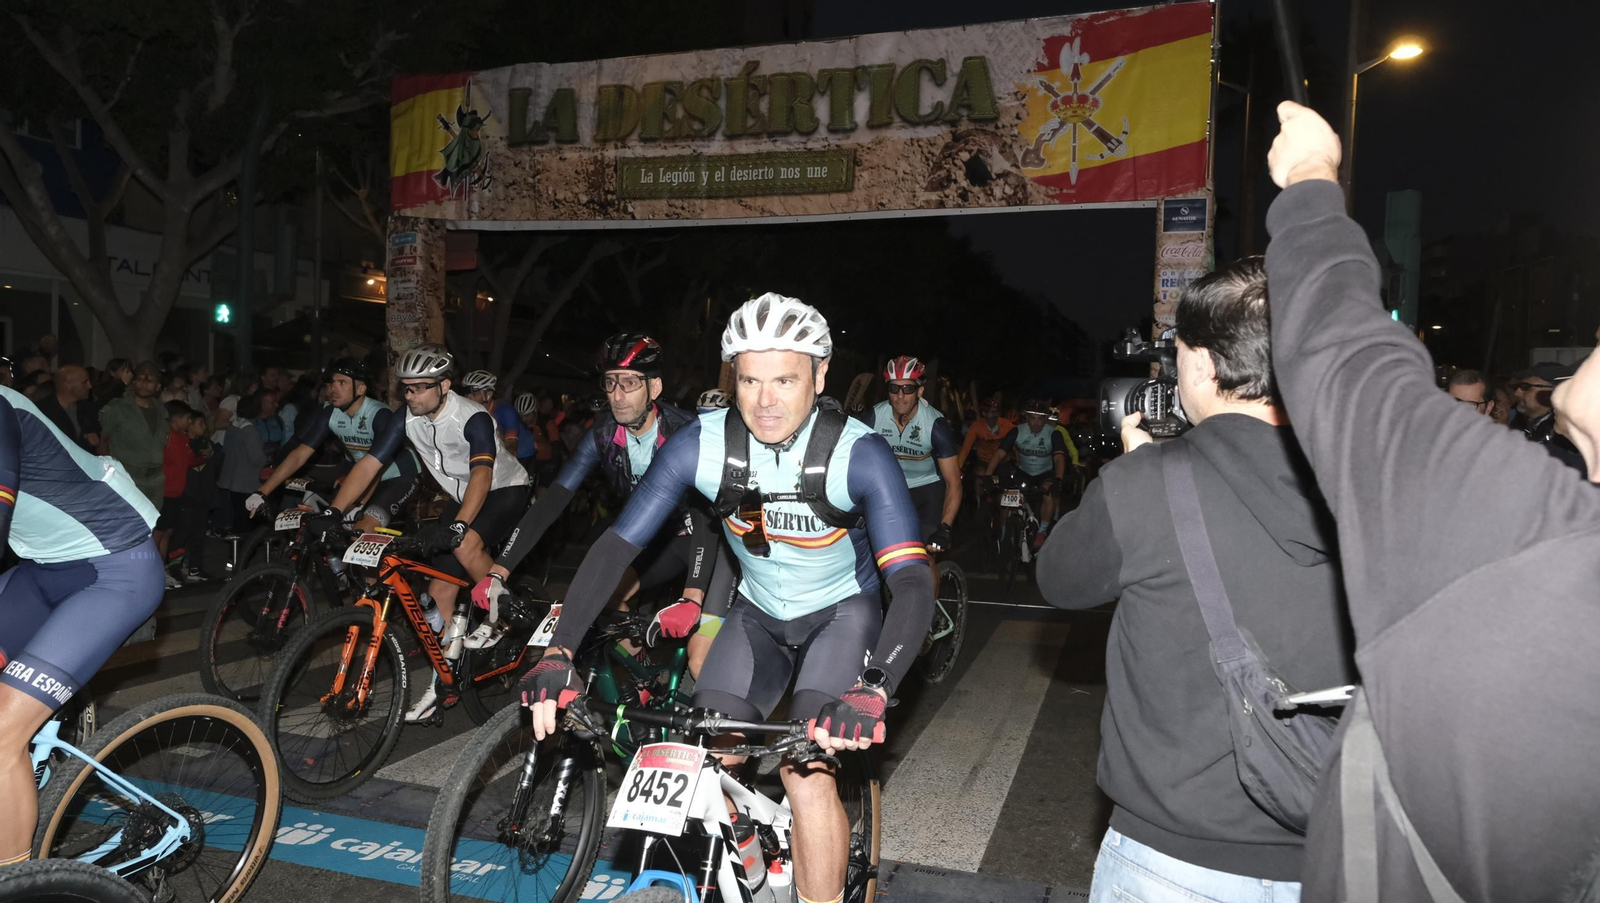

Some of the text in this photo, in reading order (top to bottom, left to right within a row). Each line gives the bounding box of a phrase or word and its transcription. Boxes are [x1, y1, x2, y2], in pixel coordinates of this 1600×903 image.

[508, 55, 1000, 146] LA DESÉRTICA
[640, 164, 828, 187] La Legión y el desierto nos une
[391, 313, 414, 323] BBVA
[892, 443, 925, 456] ESÉRTICA
[353, 541, 384, 556] 6995
[550, 779, 570, 816] FOX
[626, 769, 689, 809] 8452
[631, 811, 667, 824] cajamar
[330, 837, 507, 877] cajaar
